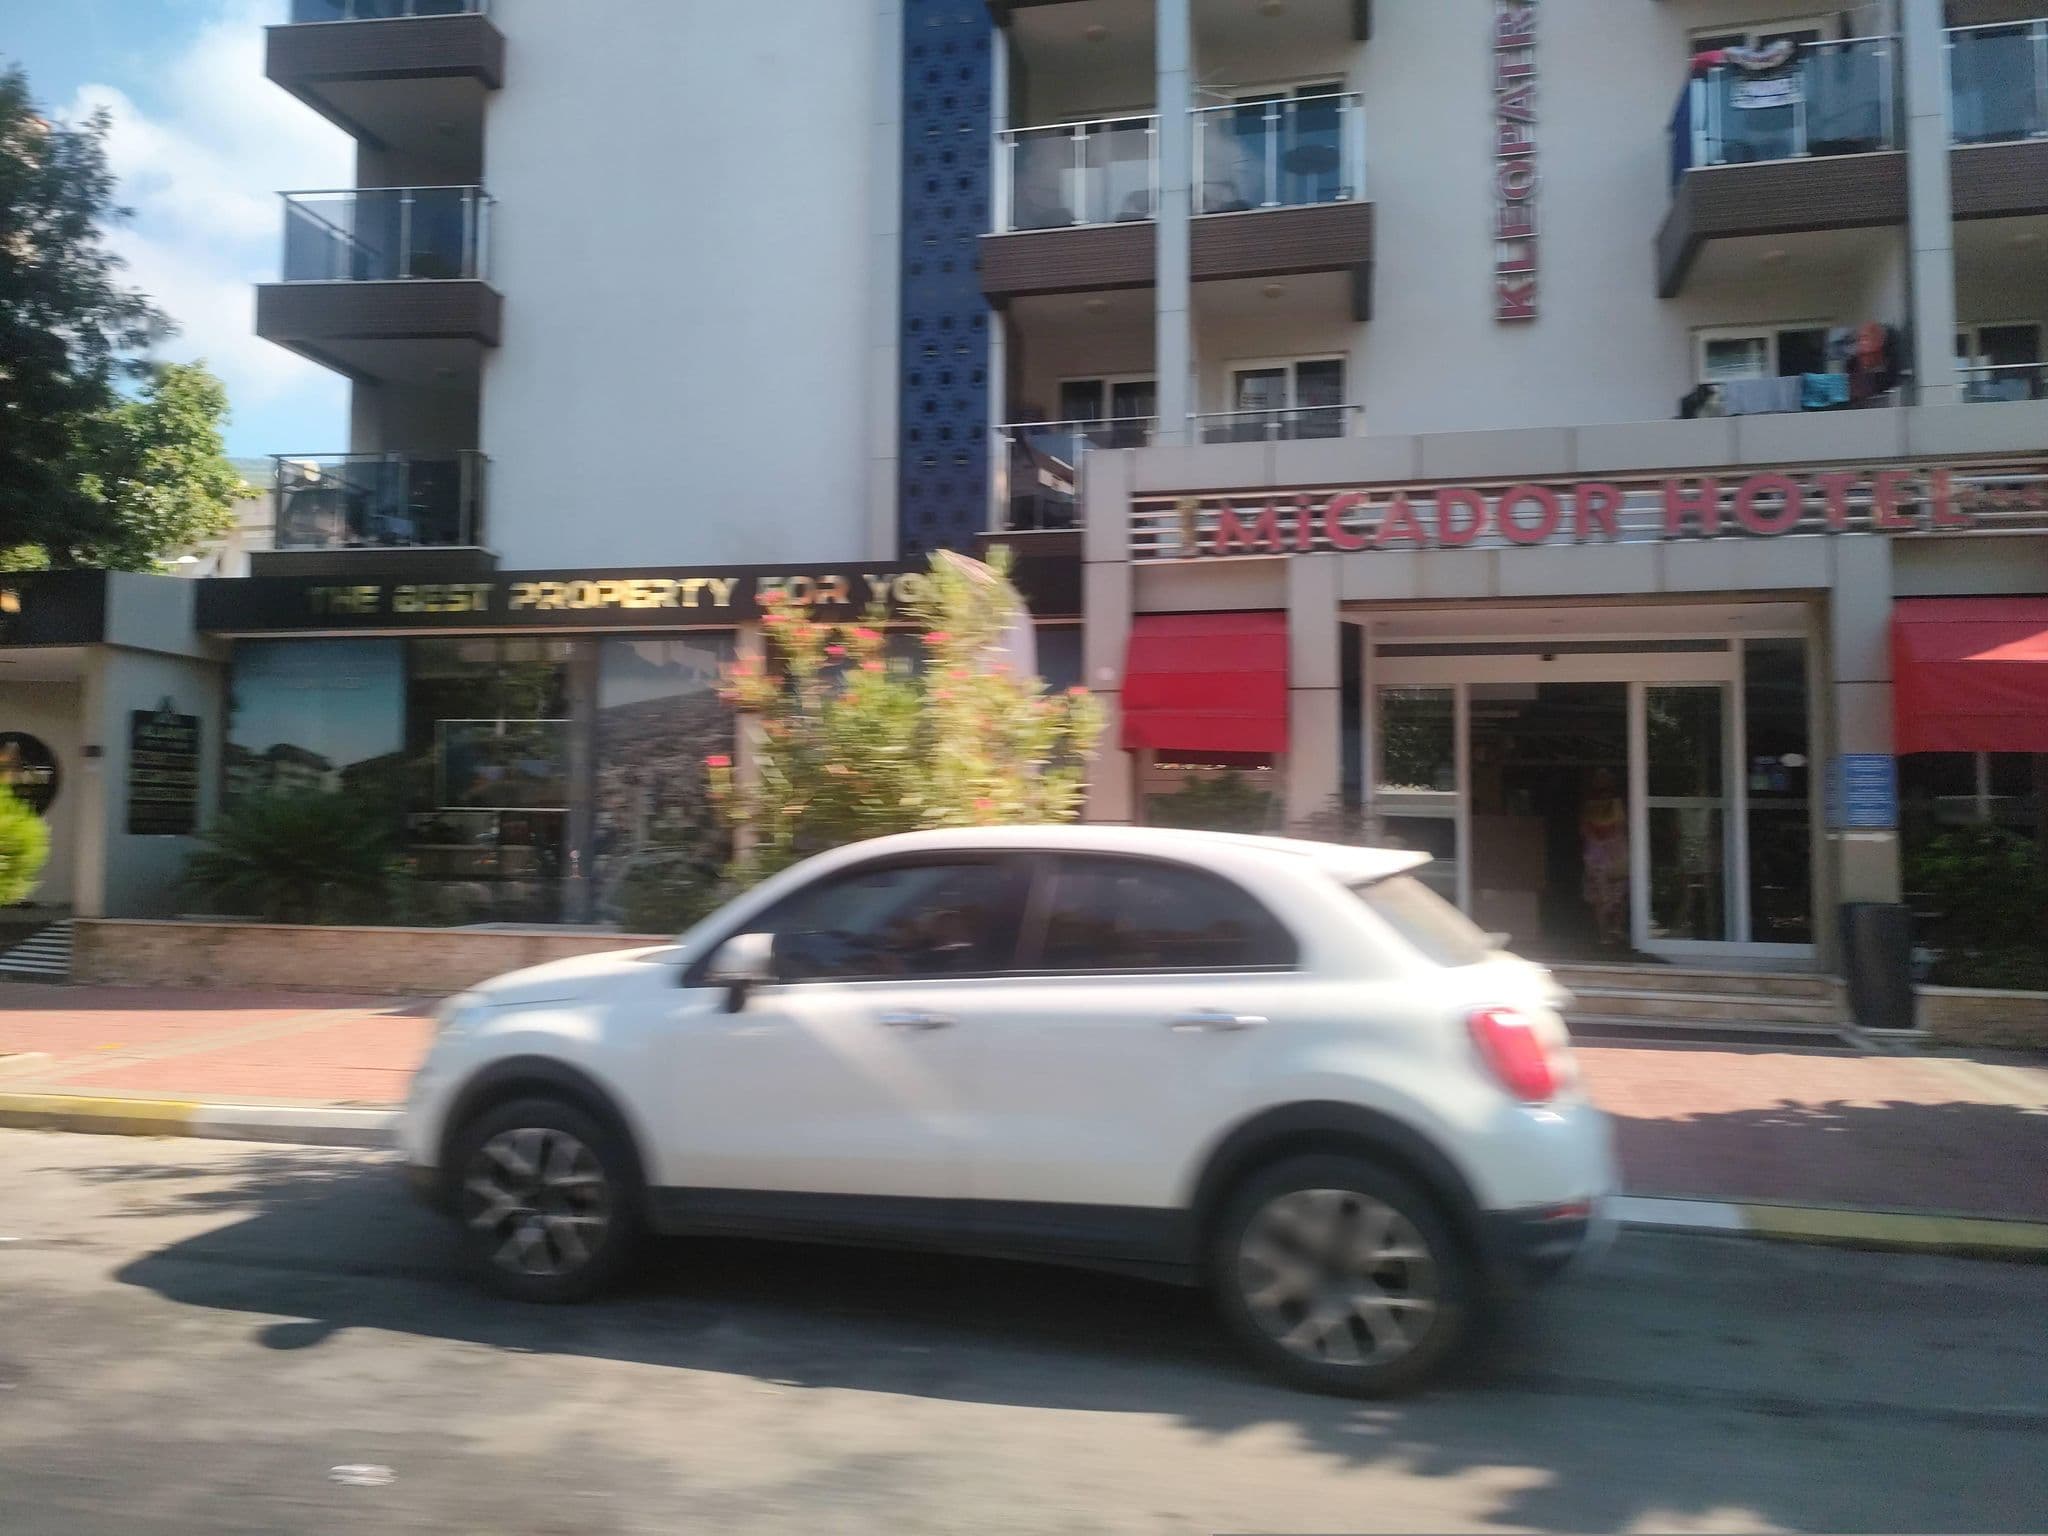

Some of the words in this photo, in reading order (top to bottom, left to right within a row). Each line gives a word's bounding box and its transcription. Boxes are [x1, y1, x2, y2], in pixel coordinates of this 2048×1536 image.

[1663, 469, 1972, 535] HOTEL
[311, 585, 381, 613] THE
[393, 583, 495, 612] BEST
[508, 577, 740, 610] PROPERTY
[756, 574, 850, 606] FOR
[862, 572, 950, 603] YO
